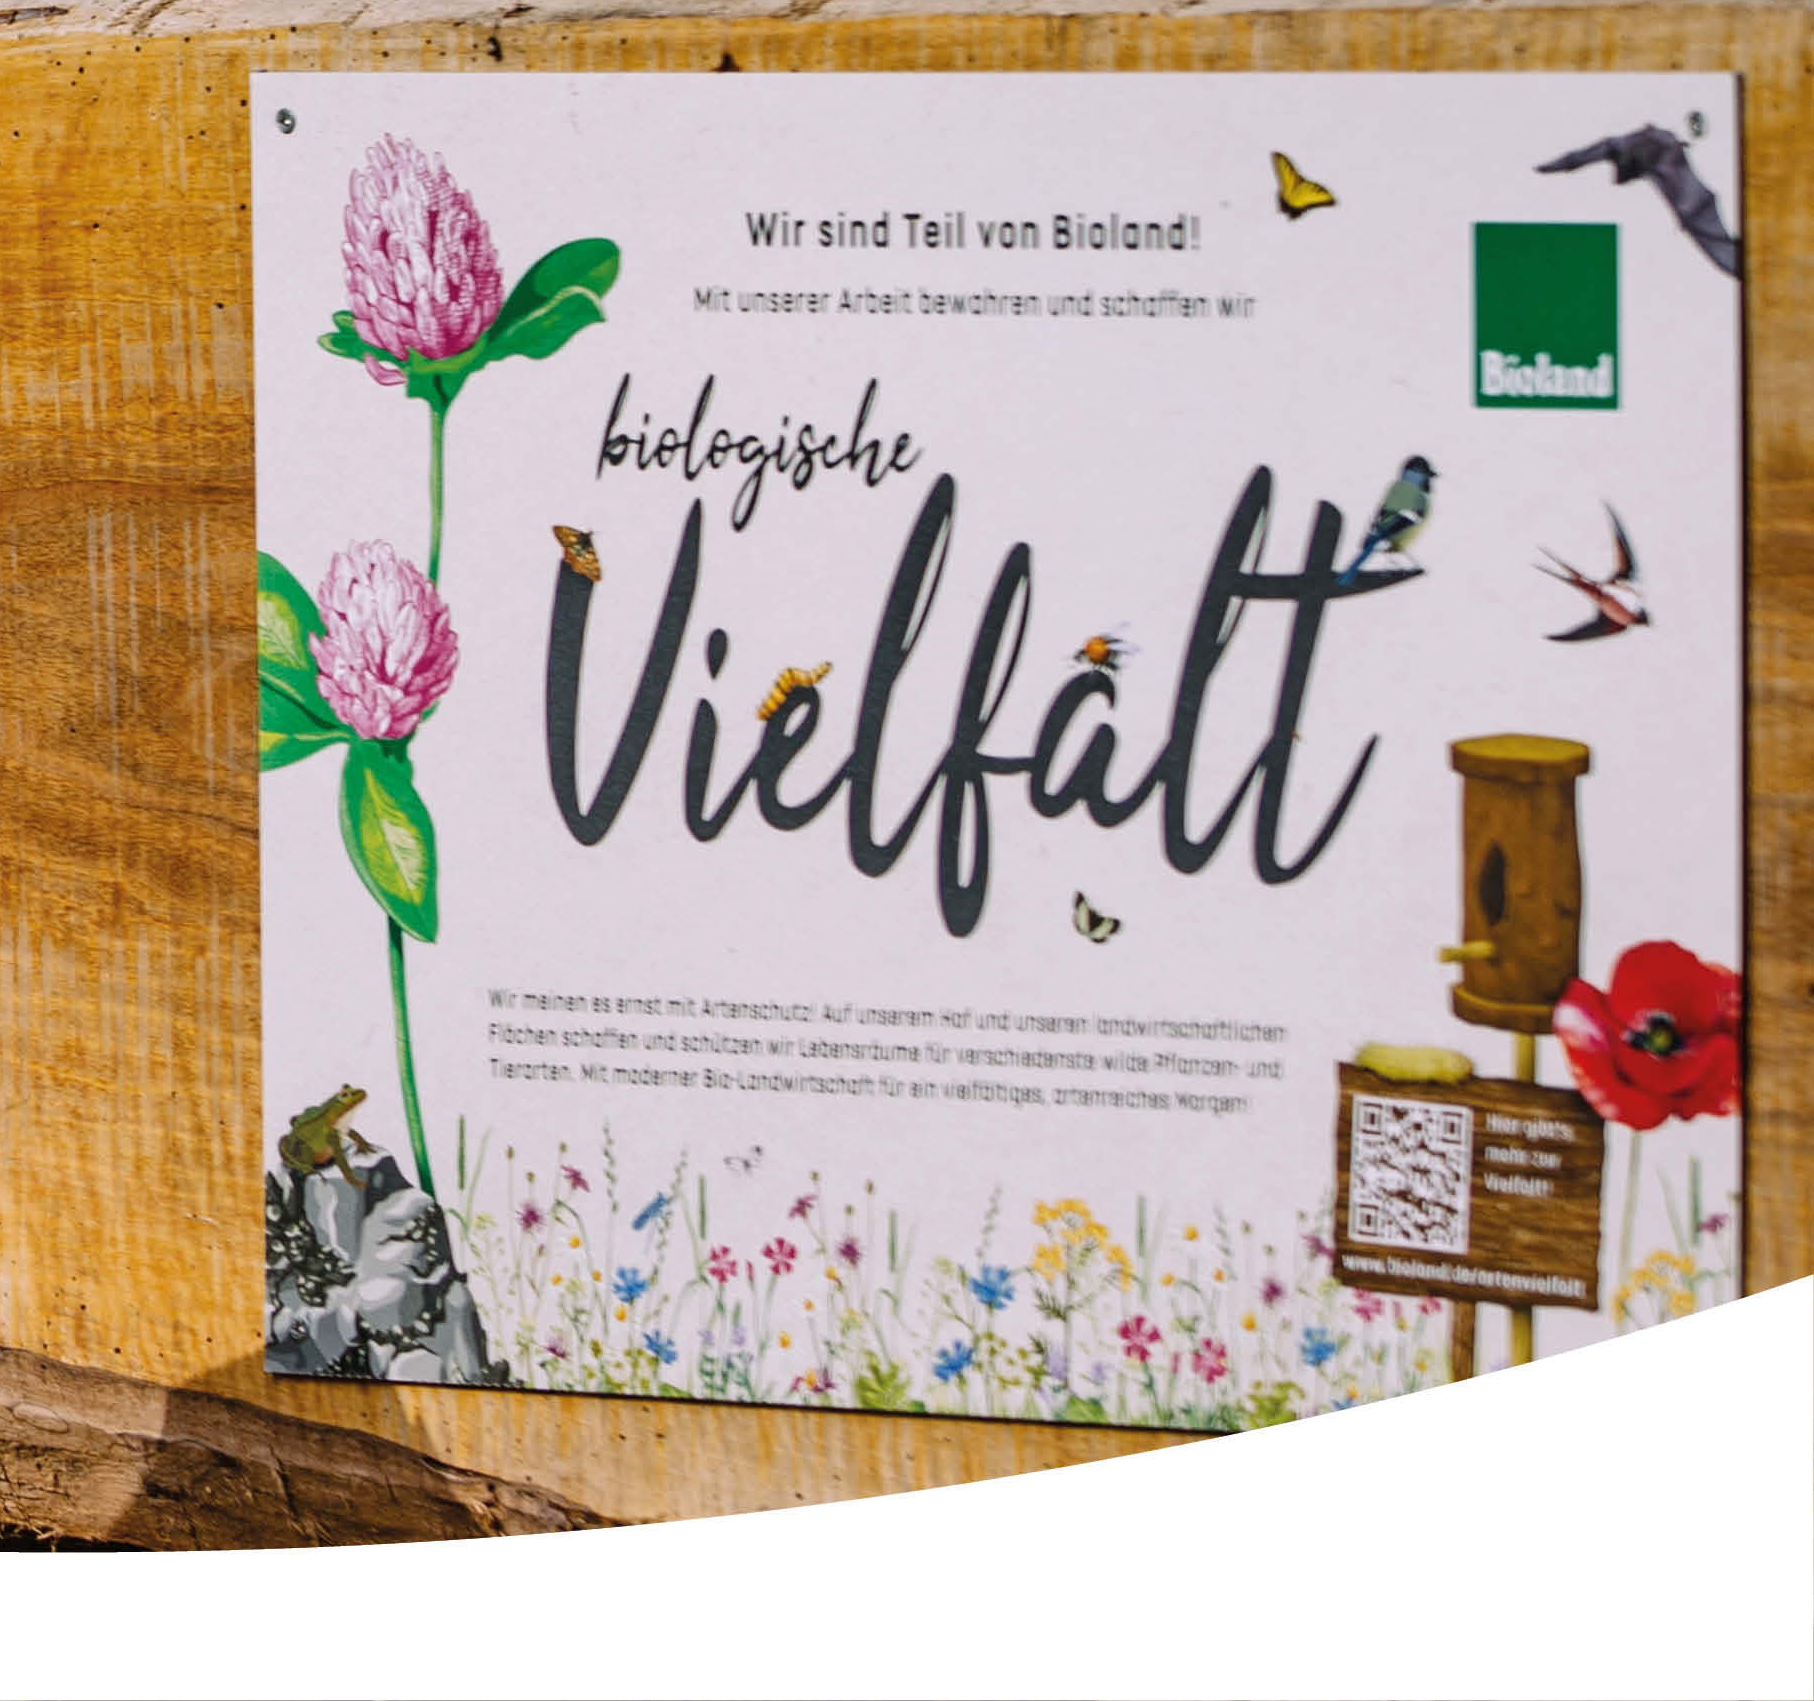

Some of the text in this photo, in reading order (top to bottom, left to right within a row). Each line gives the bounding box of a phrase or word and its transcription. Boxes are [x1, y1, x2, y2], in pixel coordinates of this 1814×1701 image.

[745, 211, 1201, 250] Wir sind Teil von Bioland!
[694, 286, 1256, 318] Mit unserer Arbeit bewahren und schaffen wir
[1480, 351, 1613, 399] Bioland
[597, 373, 923, 532] biologische
[547, 464, 1426, 939] Vielfalt
